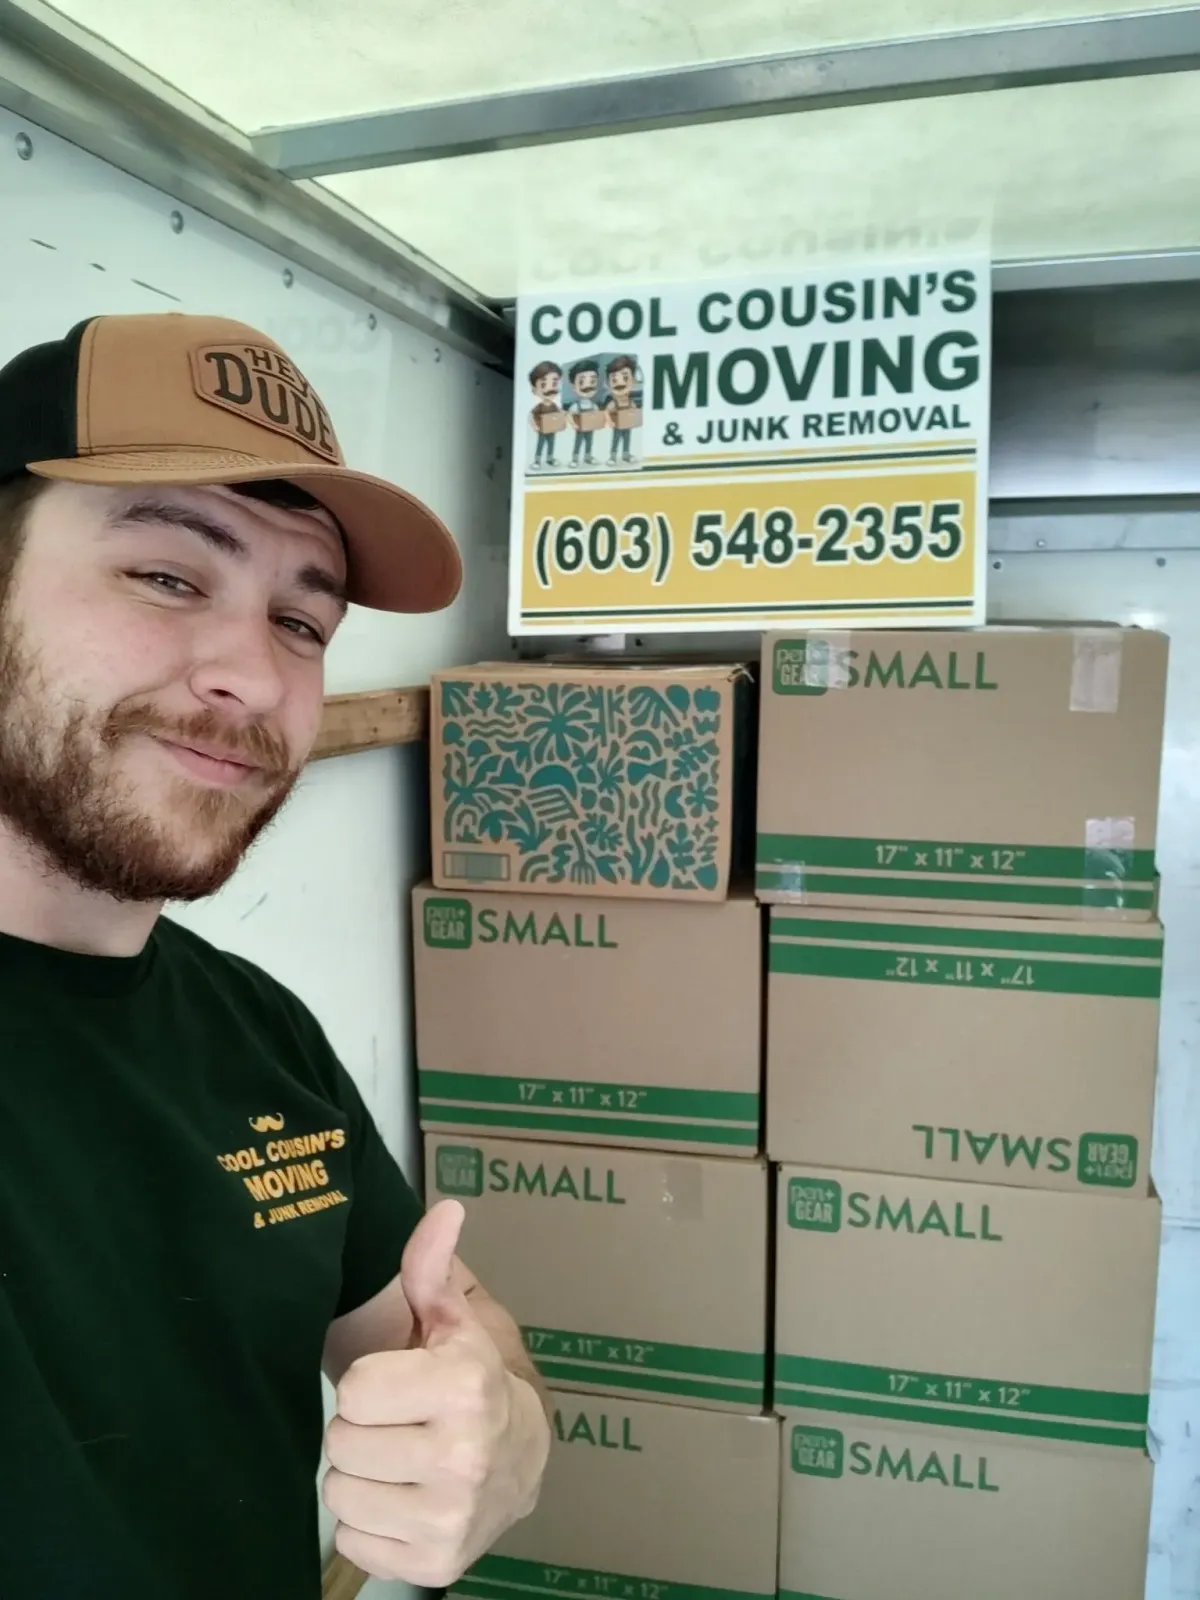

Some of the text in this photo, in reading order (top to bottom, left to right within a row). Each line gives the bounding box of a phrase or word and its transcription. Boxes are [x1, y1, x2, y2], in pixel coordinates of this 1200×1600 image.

[531, 270, 978, 345] COOL COUSIN'S
[652, 330, 980, 410] MOVING
[205, 352, 333, 453] DUDE
[662, 404, 970, 445] & JUNK REMOVAL
[534, 503, 963, 587] (603) 548-2355
[836, 648, 998, 690] SMALL
[875, 844, 1026, 870] 17" x 11" x 12"
[478, 908, 618, 949] SMALL
[925, 959, 938, 972] x
[980, 962, 994, 976] x
[216, 1129, 345, 1172] COOL COUSIN'S
[912, 1124, 1072, 1172] SMALL
[242, 1159, 329, 1201] MOVING
[489, 1158, 626, 1205] SMALL
[254, 1190, 348, 1229] & JUNK REMOVAL
[796, 1200, 832, 1224] GEAR
[847, 1191, 1003, 1241] SMALL
[888, 1374, 1031, 1405] 17" x 11" x 12"
[850, 1441, 999, 1492] SMALL
